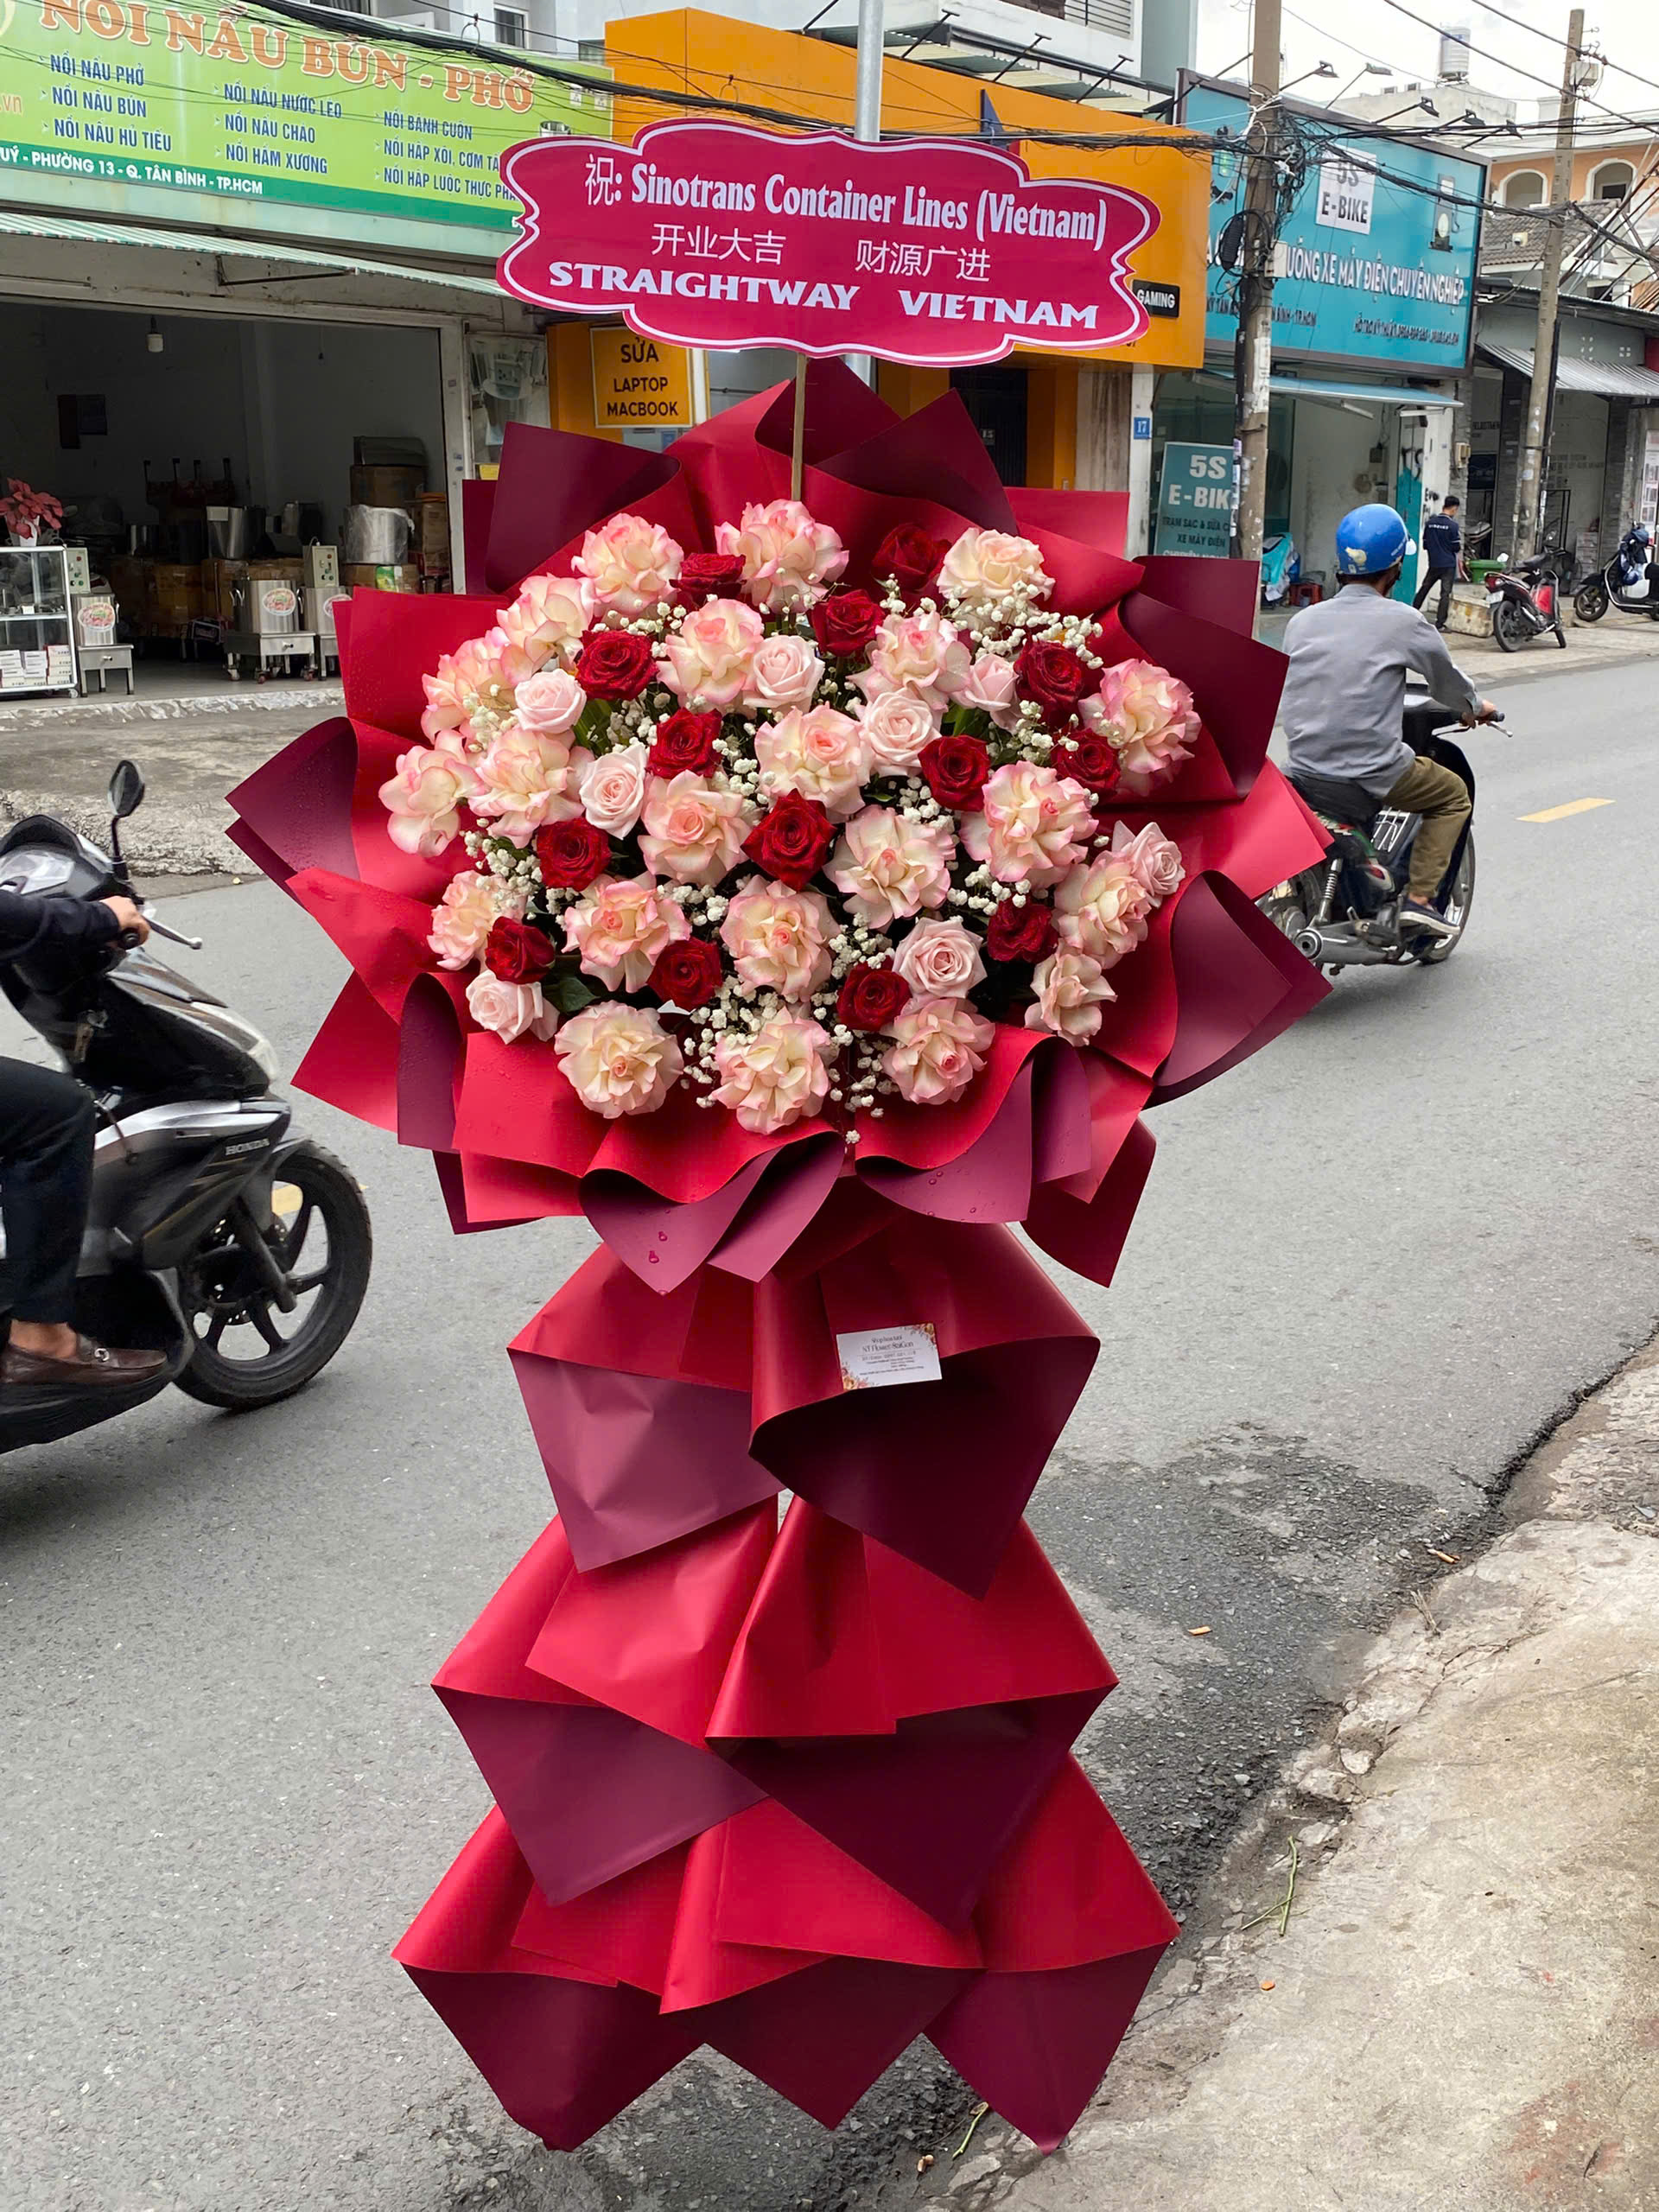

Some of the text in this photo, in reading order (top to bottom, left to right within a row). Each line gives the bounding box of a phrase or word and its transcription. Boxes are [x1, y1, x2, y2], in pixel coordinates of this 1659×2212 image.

[81, 55, 111, 80] NẤU
[116, 63, 144, 86] PHỞ
[165, 2, 289, 68] NẤU
[418, 74, 433, 87] -
[443, 66, 535, 113] PHỞ
[53, 83, 147, 118] NỒI NẤU BÚN
[251, 85, 276, 108] NẤU
[54, 115, 79, 139] NỒI
[85, 119, 114, 143] NẤU
[142, 128, 172, 152] TIẾU
[252, 115, 277, 137] NẤU
[408, 113, 438, 135] BÁNH
[31, 151, 94, 173] PHƯỜNG
[99, 160, 115, 175] 13
[125, 165, 142, 180] Q.
[144, 164, 171, 183] TÂN
[175, 167, 207, 187] BÌNH
[217, 176, 263, 194] TP.HCM
[285, 153, 327, 174] XƯƠNG
[459, 151, 483, 169] CƠM
[465, 178, 492, 200] THỰC
[632, 162, 756, 212] Sinotrans
[765, 174, 896, 224] Container
[902, 185, 969, 230] Lines
[976, 189, 1107, 251] (Vietnam)
[652, 223, 786, 265] 开业大吉
[855, 239, 991, 282] 财源广进
[1320, 251, 1337, 284] XE
[1338, 245, 1363, 289] MÁY
[1364, 249, 1388, 302] ĐIỆN
[1389, 259, 1430, 302] CHUYÊN
[1431, 264, 1465, 315] NGHIỆP
[548, 261, 1099, 329] STRAIGHTWAY VIETNAM
[1136, 289, 1175, 308] GAMING
[620, 337, 659, 364] SỬA
[613, 377, 669, 393] LAPTOP
[607, 401, 678, 416] MACBOOK
[1137, 420, 1147, 433] 17
[1189, 454, 1227, 480] 5S
[226, 1138, 270, 1155] HONDA
